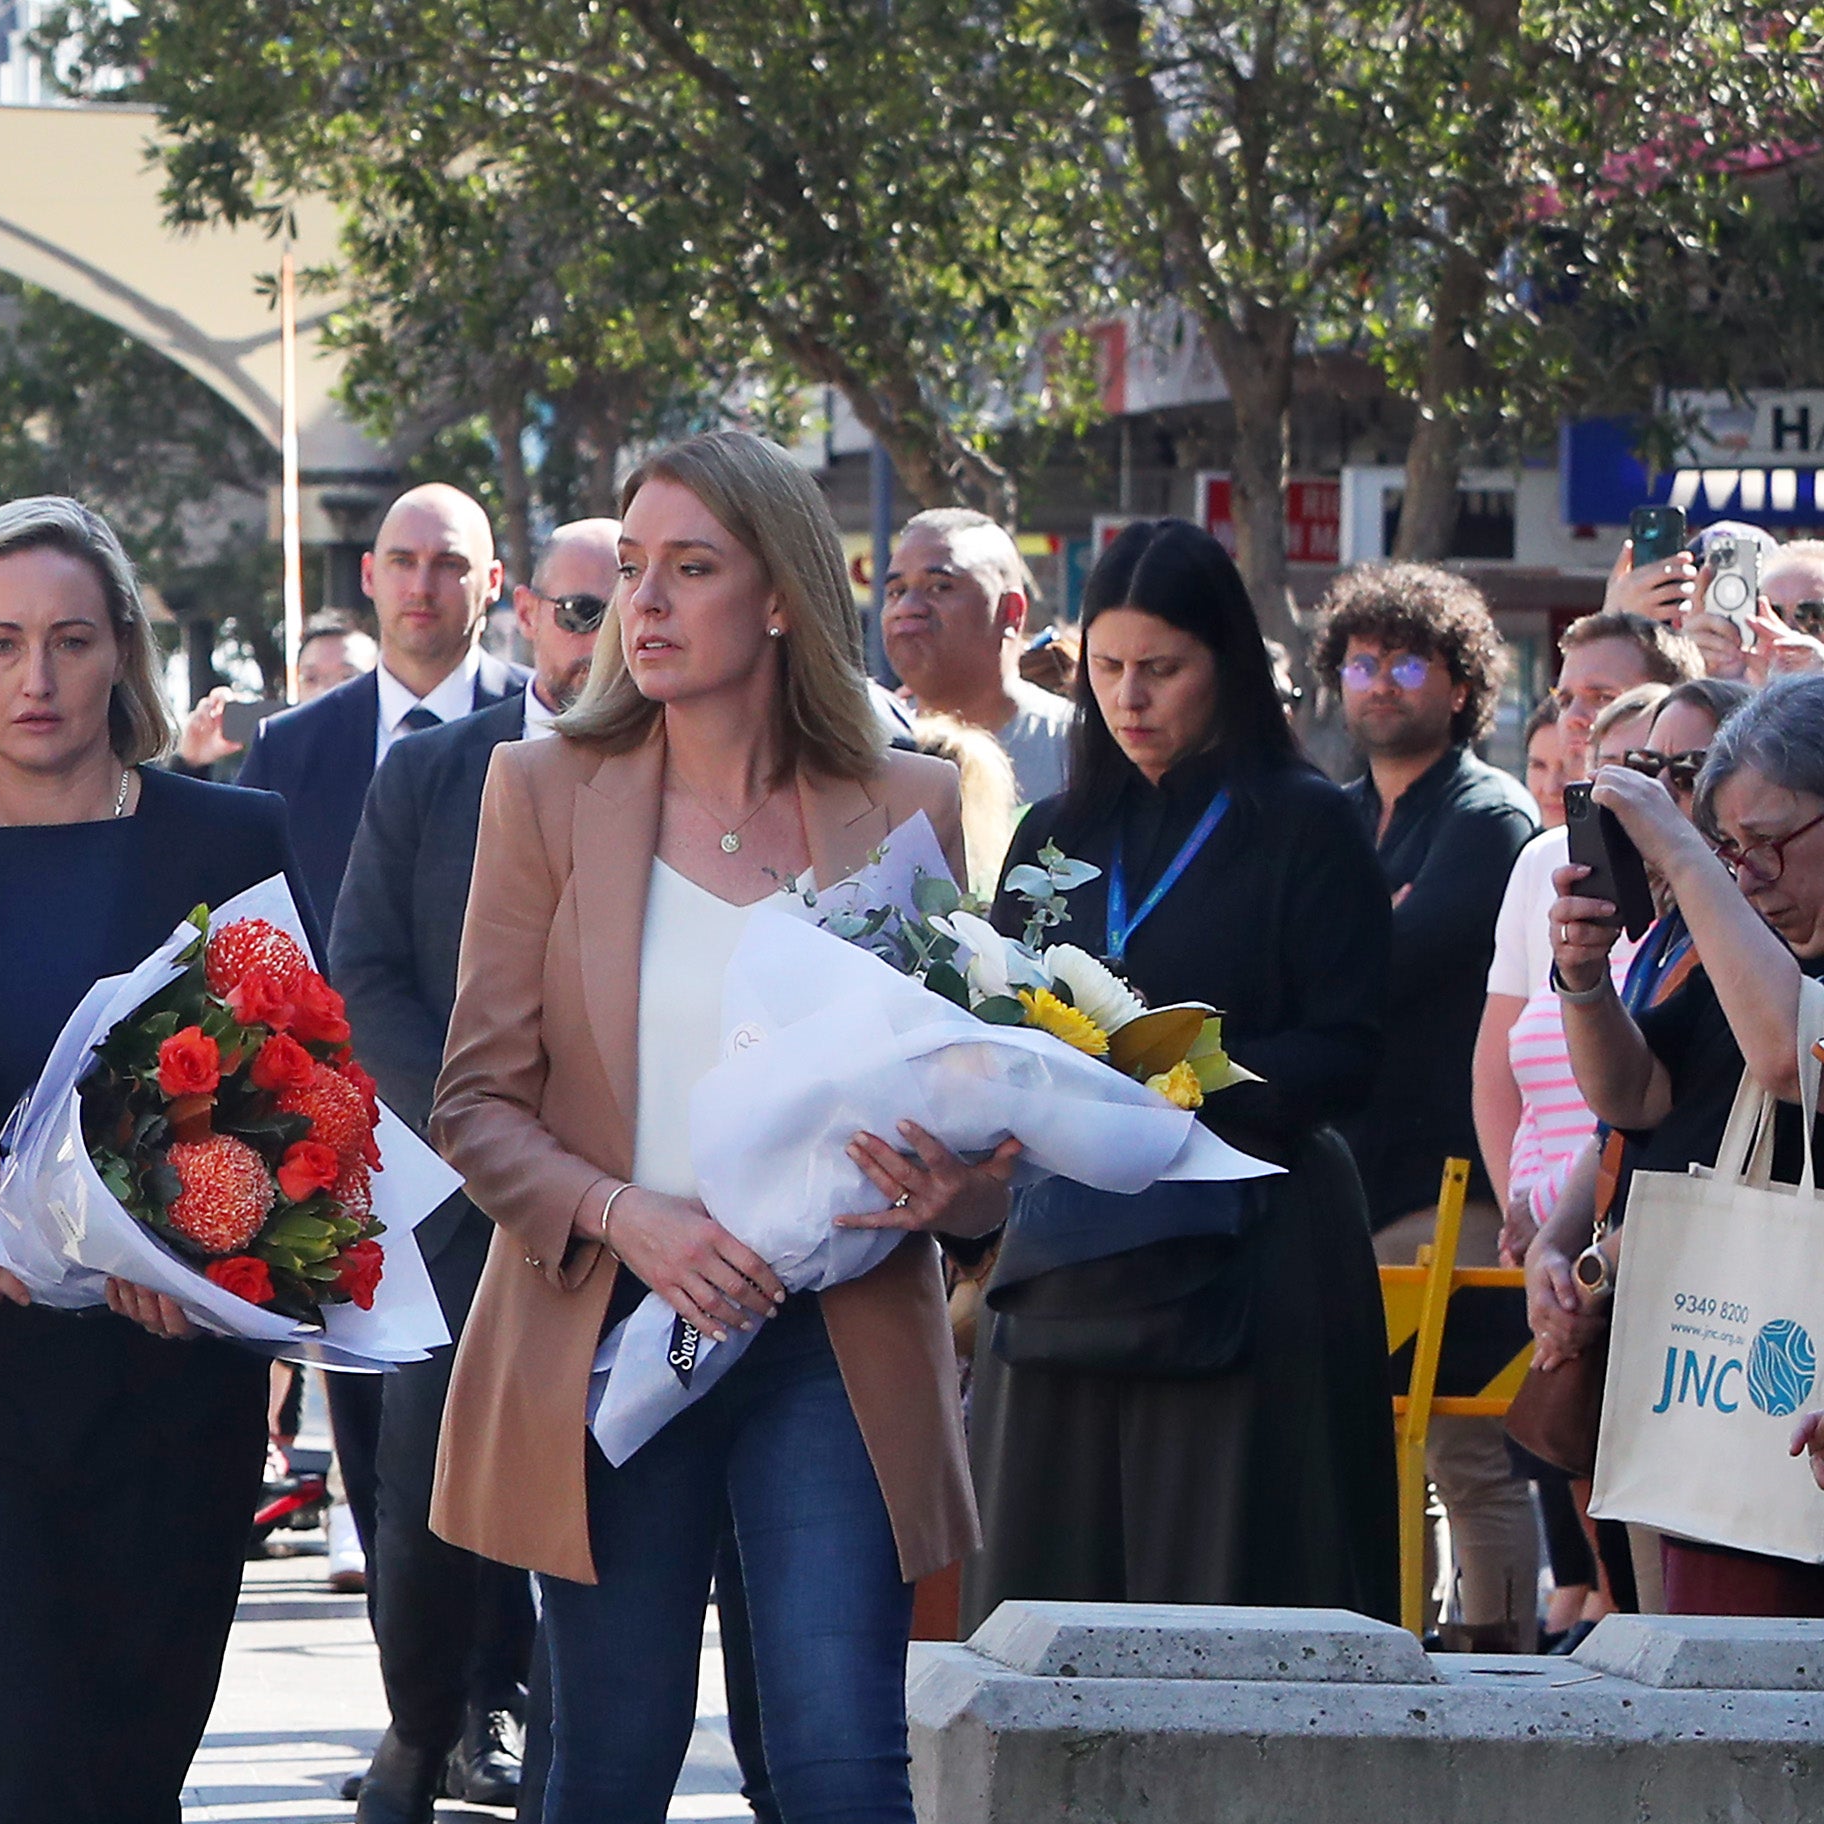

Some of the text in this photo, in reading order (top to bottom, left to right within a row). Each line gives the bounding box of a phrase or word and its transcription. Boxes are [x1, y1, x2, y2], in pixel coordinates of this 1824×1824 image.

[1674, 1293, 1749, 1325] 9349 8200
[1670, 1322, 1745, 1346] www.jnc.org.au
[1652, 1346, 1744, 1414] JNC
